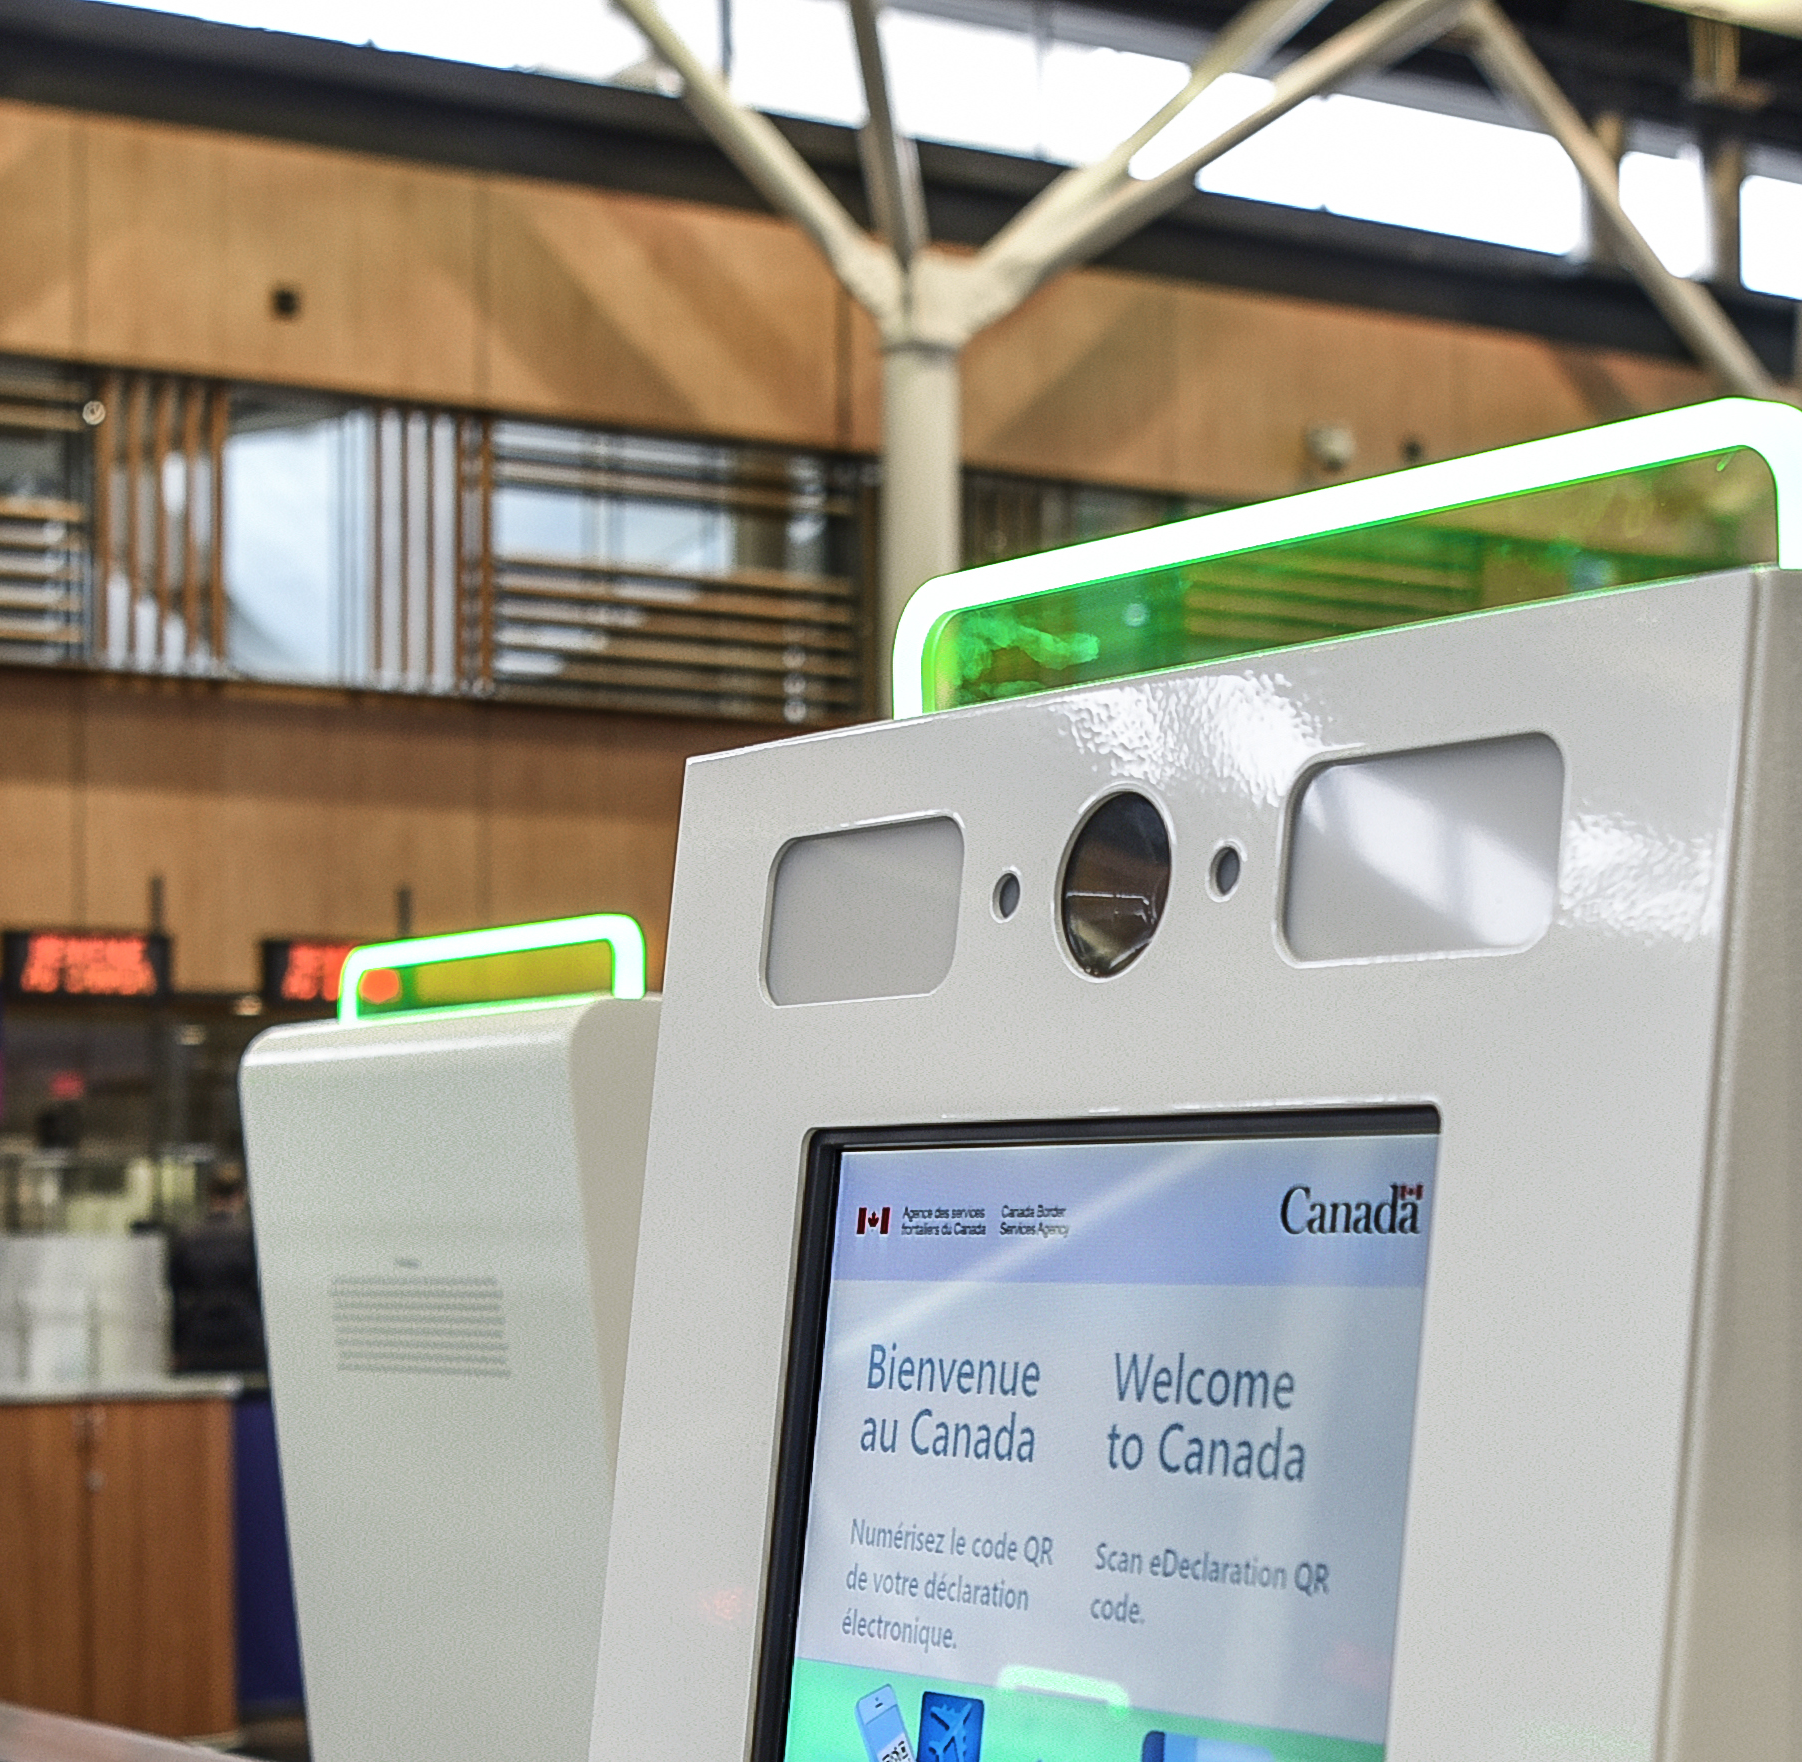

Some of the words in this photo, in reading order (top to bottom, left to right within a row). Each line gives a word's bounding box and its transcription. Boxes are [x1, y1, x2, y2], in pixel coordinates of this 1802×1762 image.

[901, 1222, 939, 1235] frontaliers
[941, 1222, 952, 1235] du
[954, 1222, 987, 1235] Canada
[902, 1206, 933, 1222] Agence
[934, 1206, 949, 1219] des
[951, 1206, 985, 1219] services
[1000, 1222, 1035, 1235] Services
[1037, 1222, 1070, 1238] Agency
[1001, 1205, 1034, 1218] Canada
[1037, 1204, 1066, 1218] Border
[1281, 1183, 1420, 1235] Canada
[867, 1342, 1041, 1398] Bienvenue
[1115, 1352, 1294, 1410] Welcome
[860, 1415, 898, 1453] au
[910, 1408, 1036, 1463] Canada
[1108, 1424, 1143, 1471] to
[1159, 1422, 1305, 1483] Canada
[850, 1518, 945, 1554] Numérisez
[950, 1527, 966, 1556] le
[972, 1531, 1017, 1561] code
[1023, 1535, 1054, 1568] QR
[846, 1562, 868, 1591] de
[872, 1572, 919, 1598] votre
[924, 1571, 1029, 1611] déclaration
[1095, 1542, 1143, 1575] Scan
[1149, 1548, 1287, 1589] eDeclaration
[1294, 1562, 1330, 1597] QR
[842, 1607, 957, 1653] électronique.
[1089, 1592, 1145, 1624] code.
